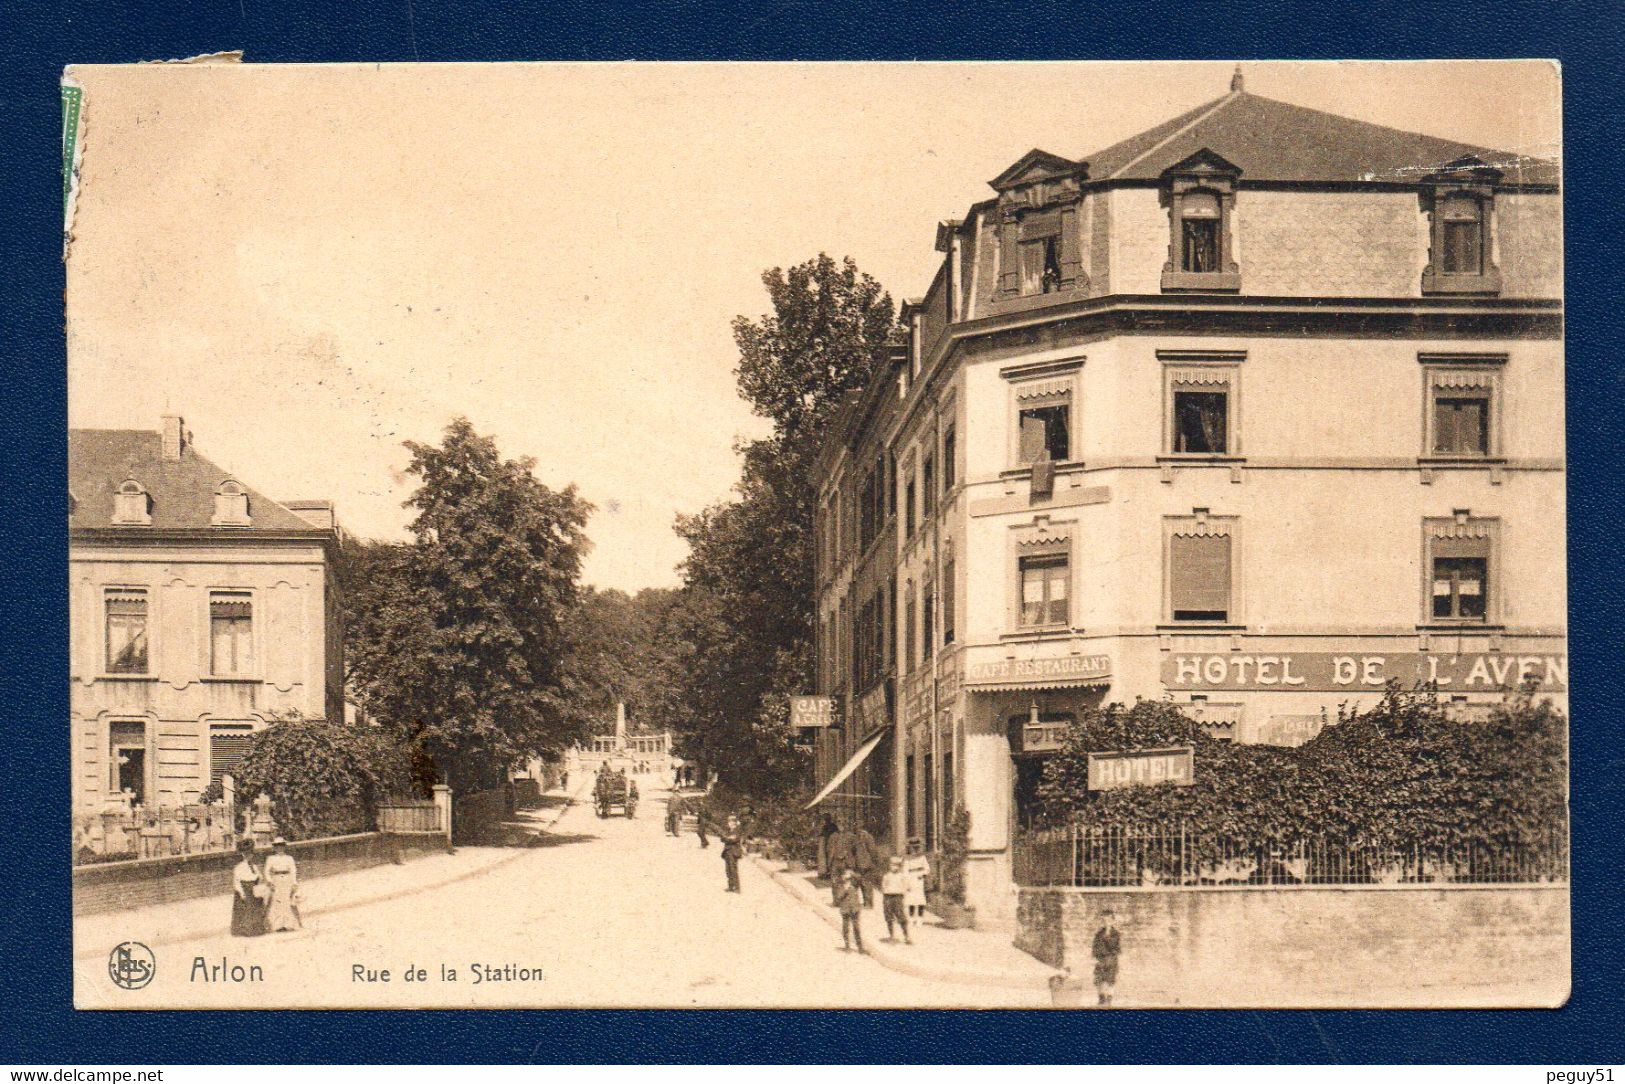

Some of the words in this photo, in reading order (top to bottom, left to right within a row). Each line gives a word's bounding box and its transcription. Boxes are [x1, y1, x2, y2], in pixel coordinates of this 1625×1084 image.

[1015, 655, 1111, 676] RESTAURANT
[1175, 656, 1305, 685] HOTEL
[1333, 656, 1386, 685] DE
